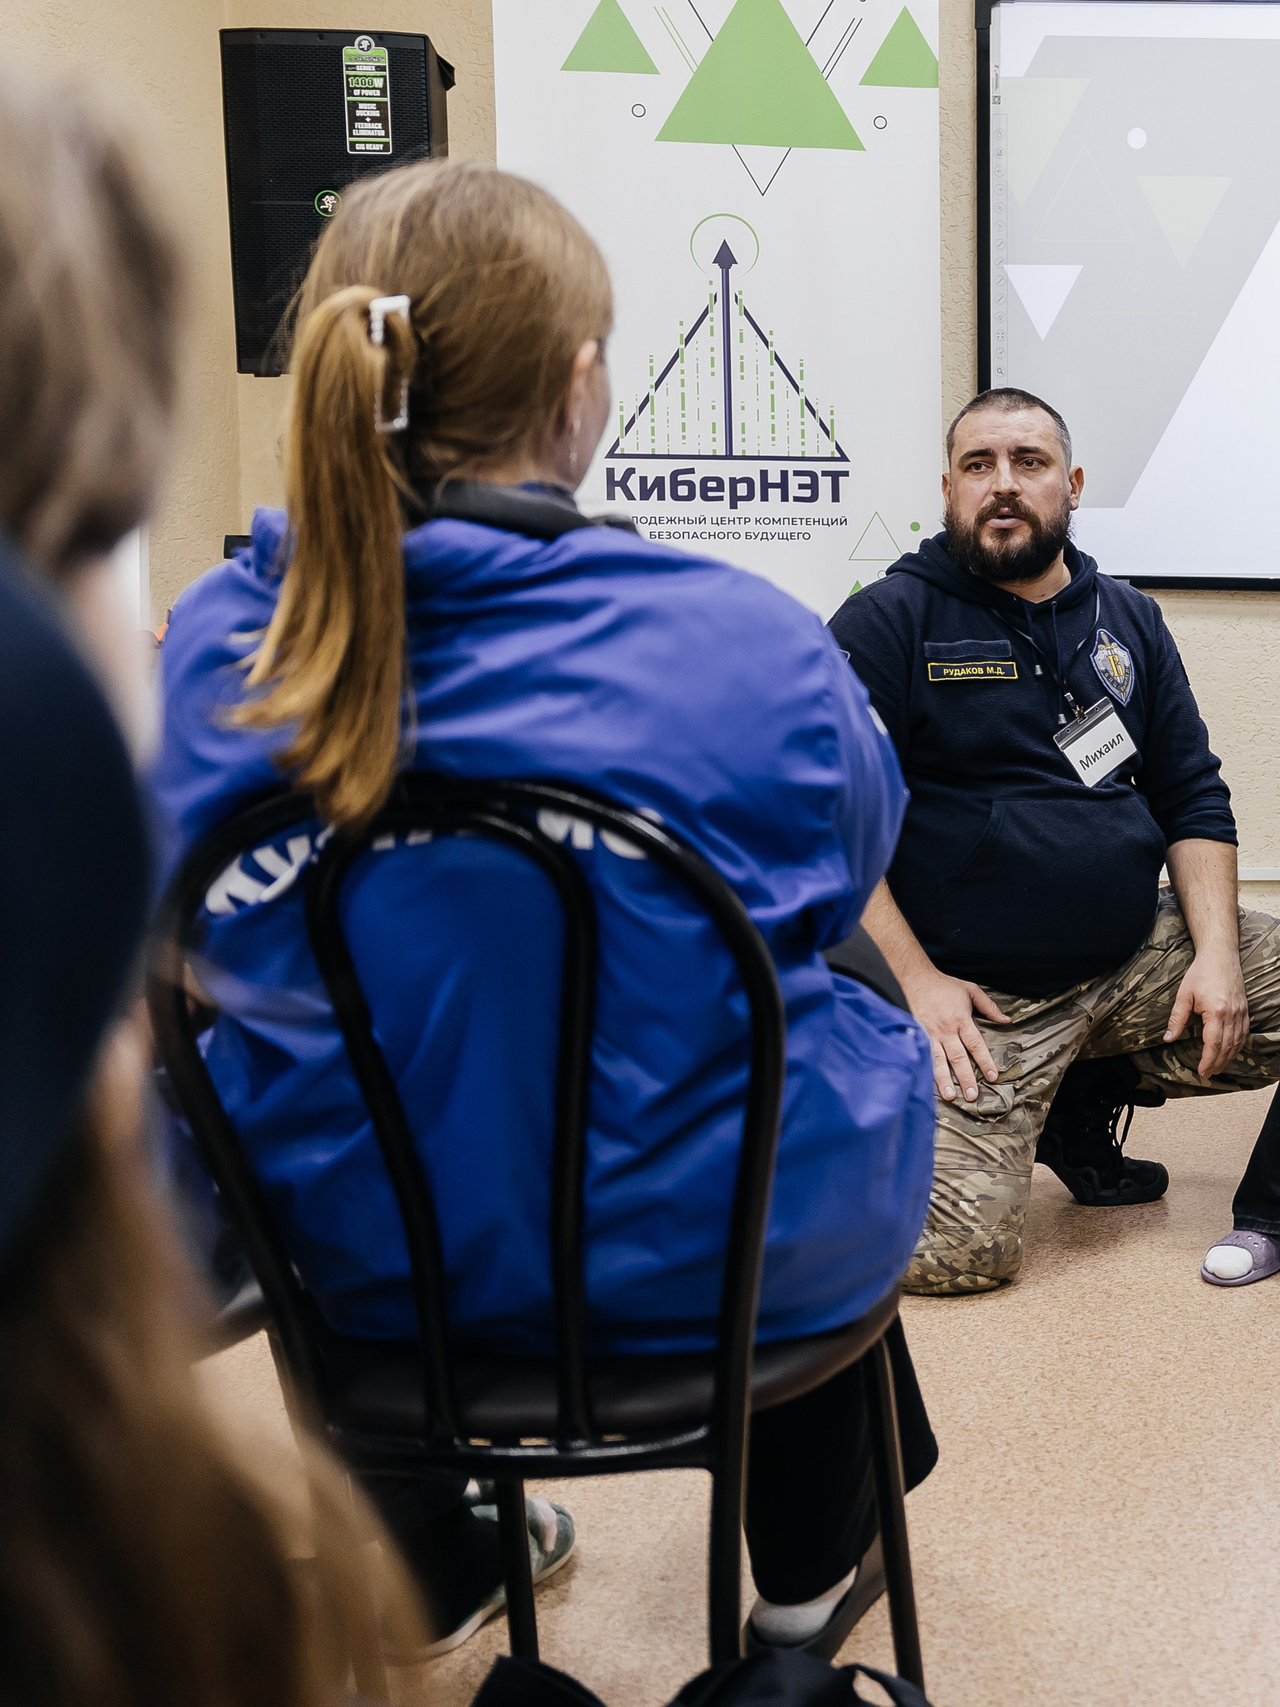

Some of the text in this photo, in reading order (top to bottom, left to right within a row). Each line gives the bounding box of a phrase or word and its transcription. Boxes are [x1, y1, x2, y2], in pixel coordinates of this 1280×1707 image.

[348, 77, 384, 88] 1400W
[605, 466, 850, 510] КиберНЭТ
[710, 516, 752, 527] ЦЕНТР
[754, 515, 848, 528] КОМПЕТЕНЦИЙ
[649, 530, 812, 542] БЕЗОПАСНОГО БУДУЩЕГО
[943, 666, 1006, 677] РУДАКОВ М.Д.
[1078, 732, 1125, 772] Михаил
